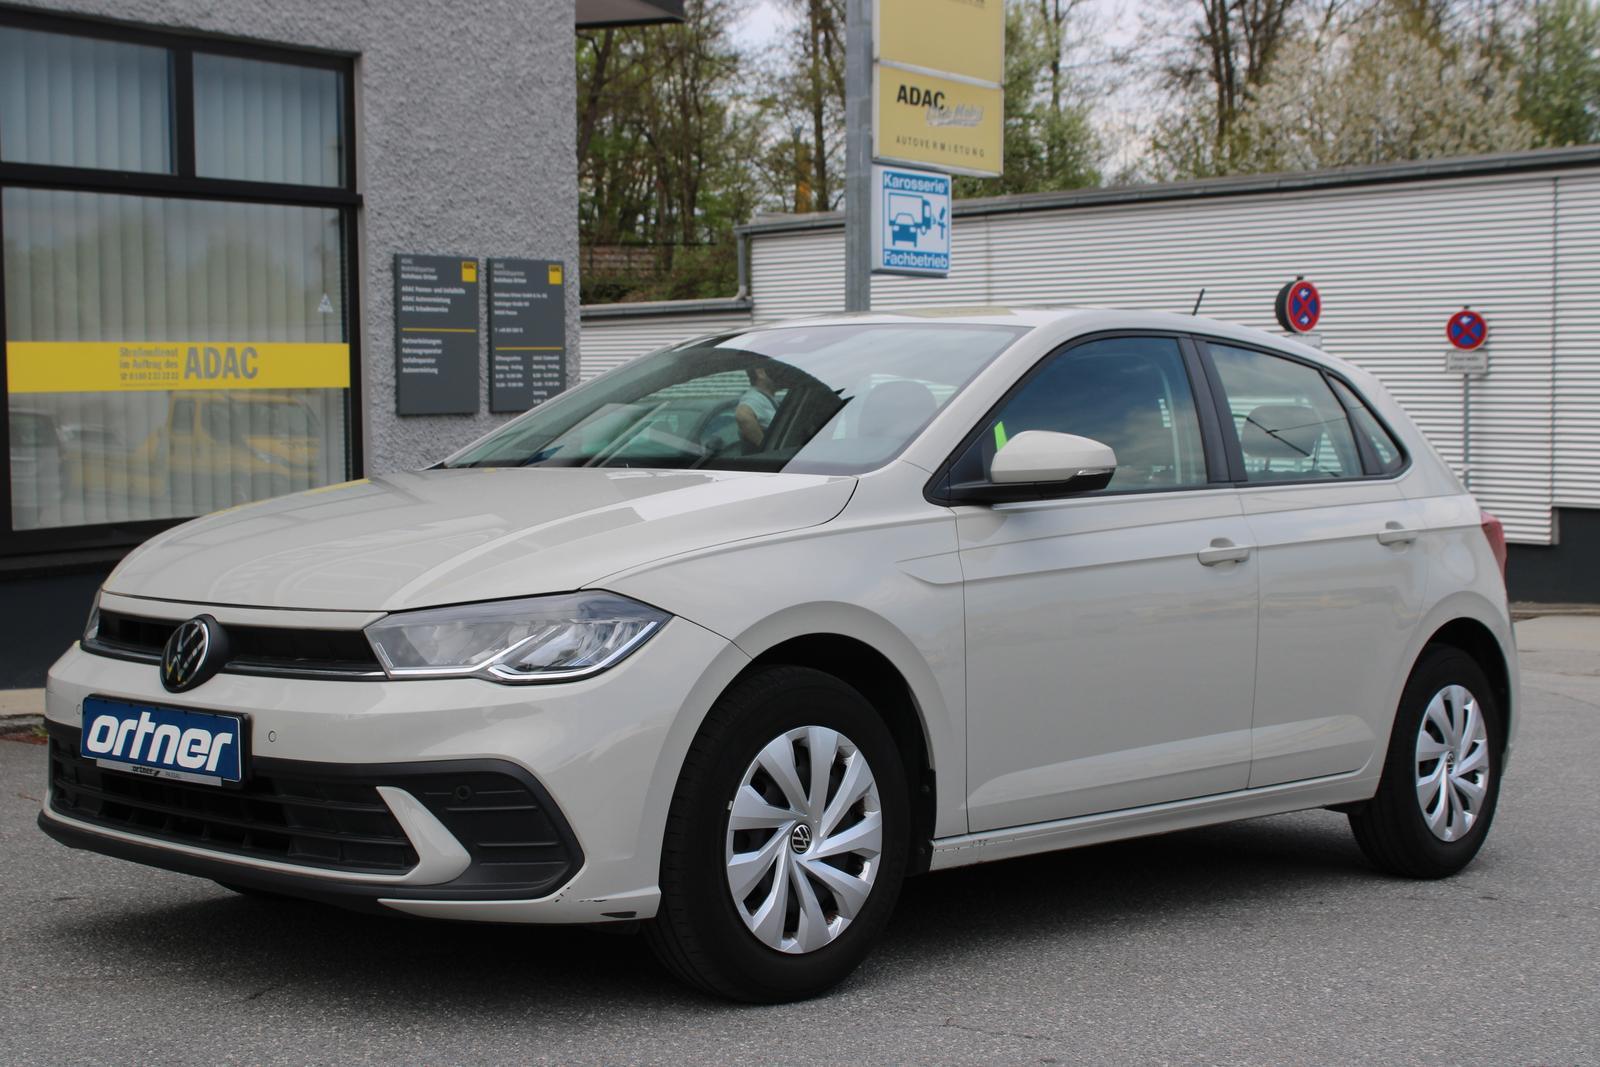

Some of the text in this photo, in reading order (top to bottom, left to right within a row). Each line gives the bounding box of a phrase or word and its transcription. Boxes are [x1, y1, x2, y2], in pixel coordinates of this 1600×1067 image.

[897, 84, 945, 110] ADAC
[896, 135, 985, 158] AUTOVERMIETUNG
[884, 173, 945, 194] Karosserie
[884, 251, 947, 268] Fachbetrieb
[184, 347, 258, 380] ADAC
[87, 712, 233, 771] ortner
